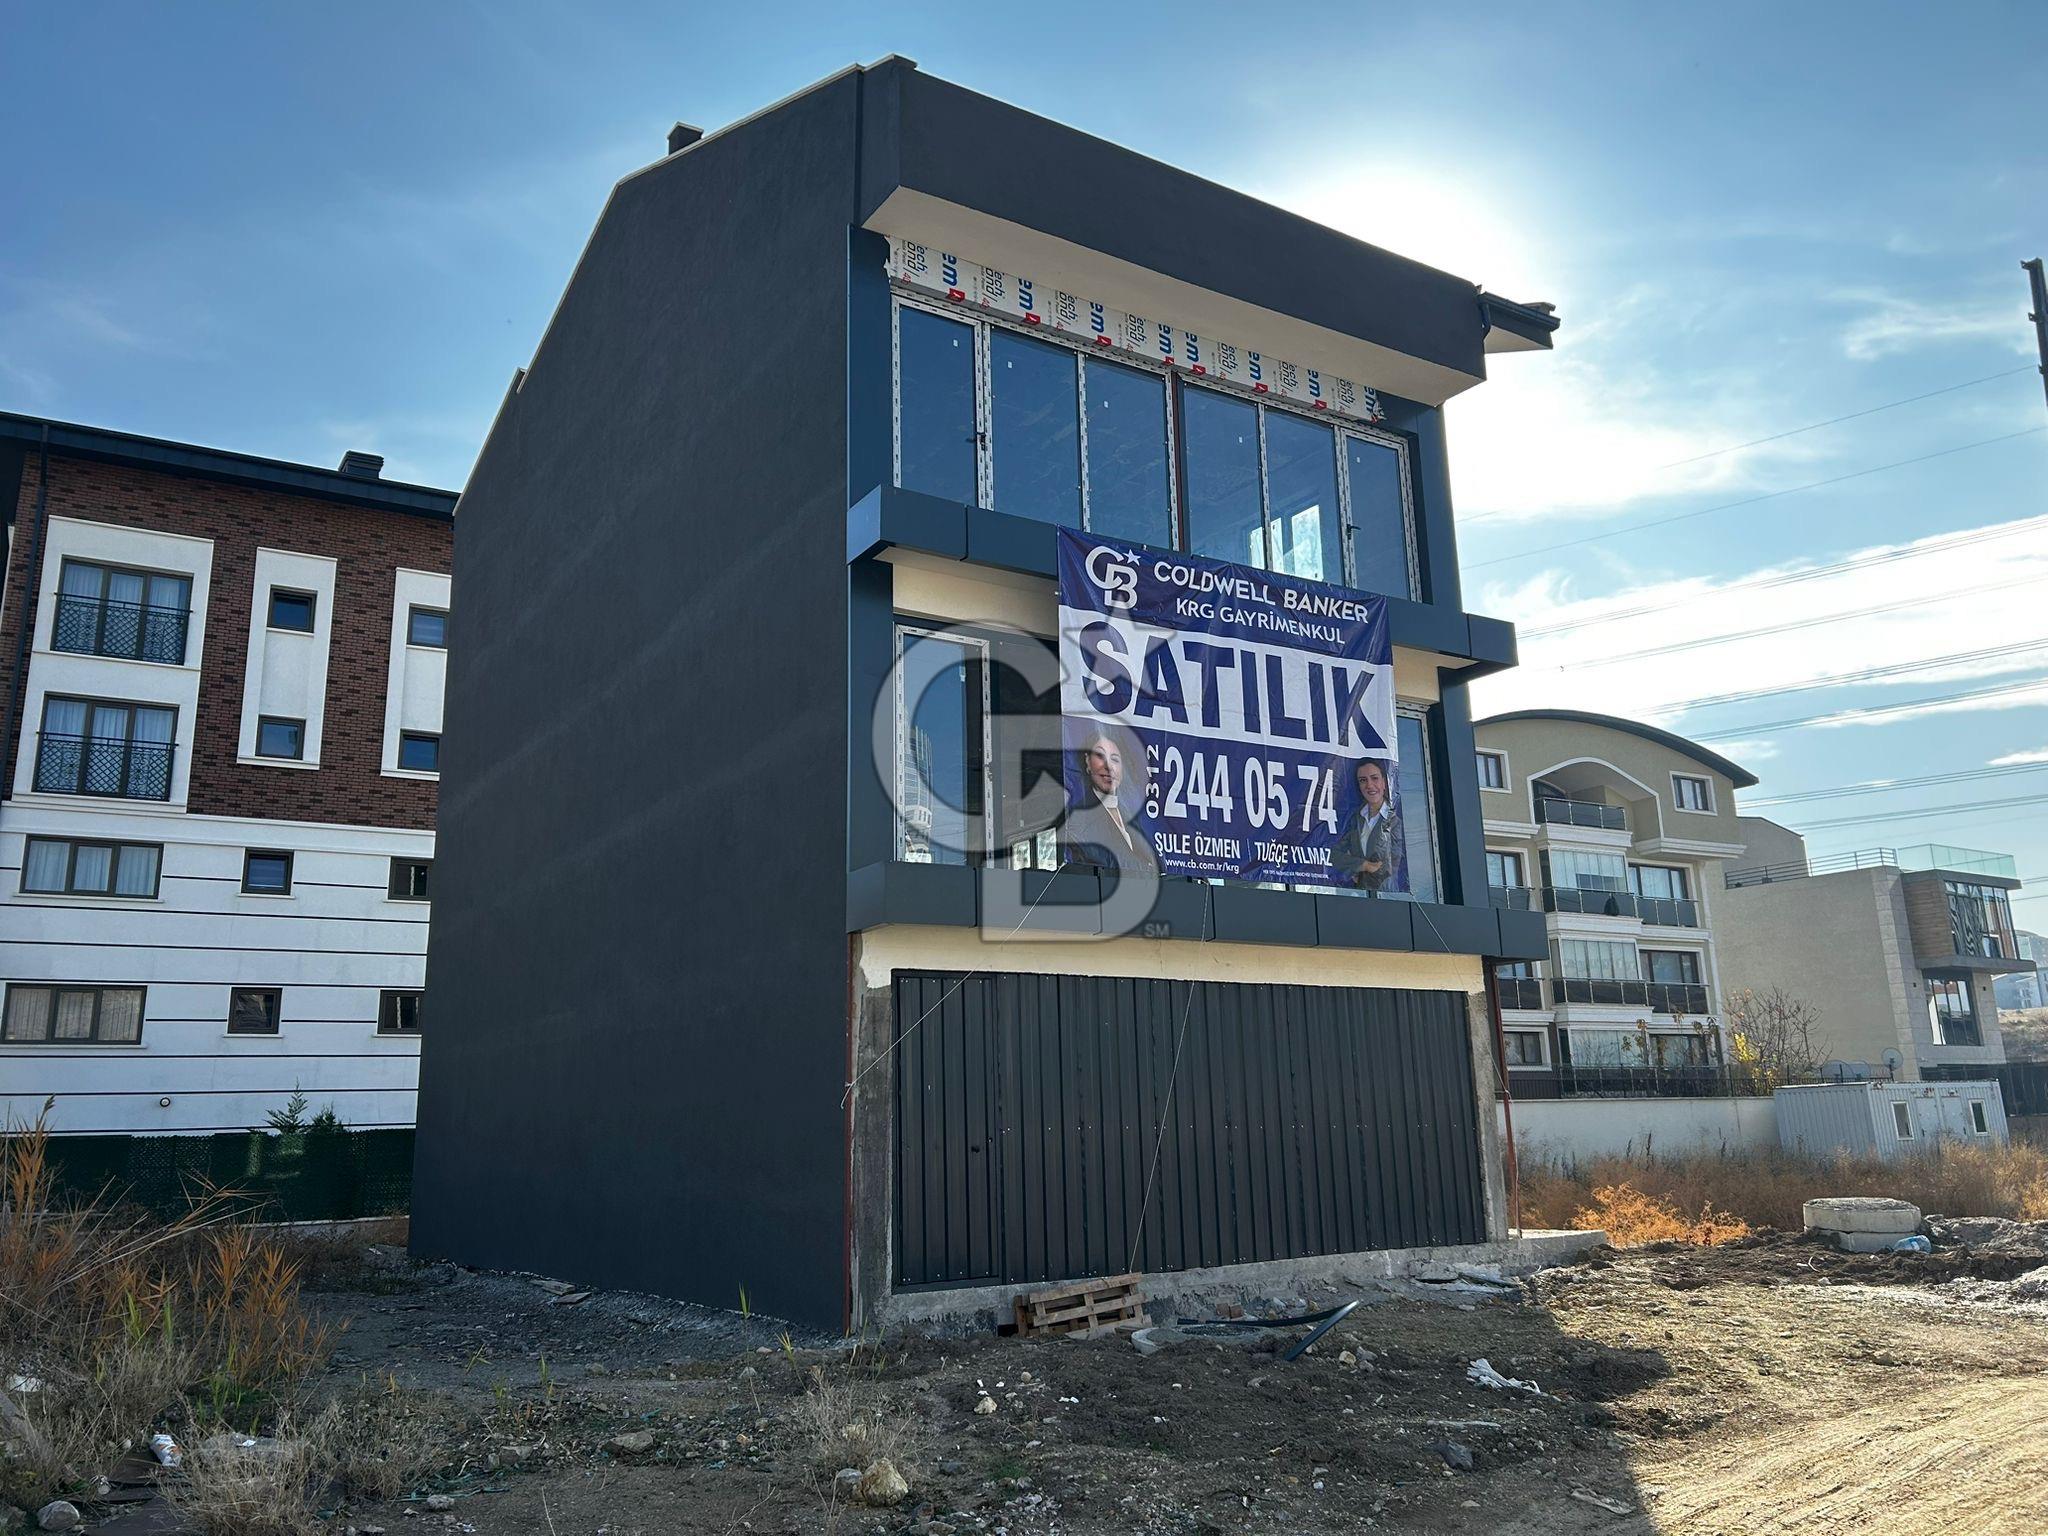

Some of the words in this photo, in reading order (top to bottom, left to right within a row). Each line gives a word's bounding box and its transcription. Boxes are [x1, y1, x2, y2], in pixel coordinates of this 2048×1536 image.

[917, 245, 928, 272] ech
[995, 271, 1005, 297] ech
[1067, 296, 1078, 321] ech
[1136, 318, 1147, 343] ech
[1228, 346, 1238, 370] ech
[1288, 362, 1298, 388] ech
[1154, 561, 1276, 606] COLDWELL
[1283, 589, 1369, 623] BANKER
[1176, 597, 1215, 619] KRG
[1219, 606, 1346, 644] GAYRİMENKUL
[1079, 620, 1388, 750] SATILIK
[1145, 744, 1160, 819] 0312
[1164, 746, 1234, 823] 244
[1243, 757, 1290, 830] 05
[1297, 765, 1338, 834] 74
[1154, 832, 1191, 856] ŞULE
[1194, 831, 1241, 859] ÖZMEN
[1254, 838, 1289, 868] TUĞÇE
[1290, 845, 1333, 867] YILMAZ
[1165, 858, 1240, 874] www.cb.com.tr/krg
